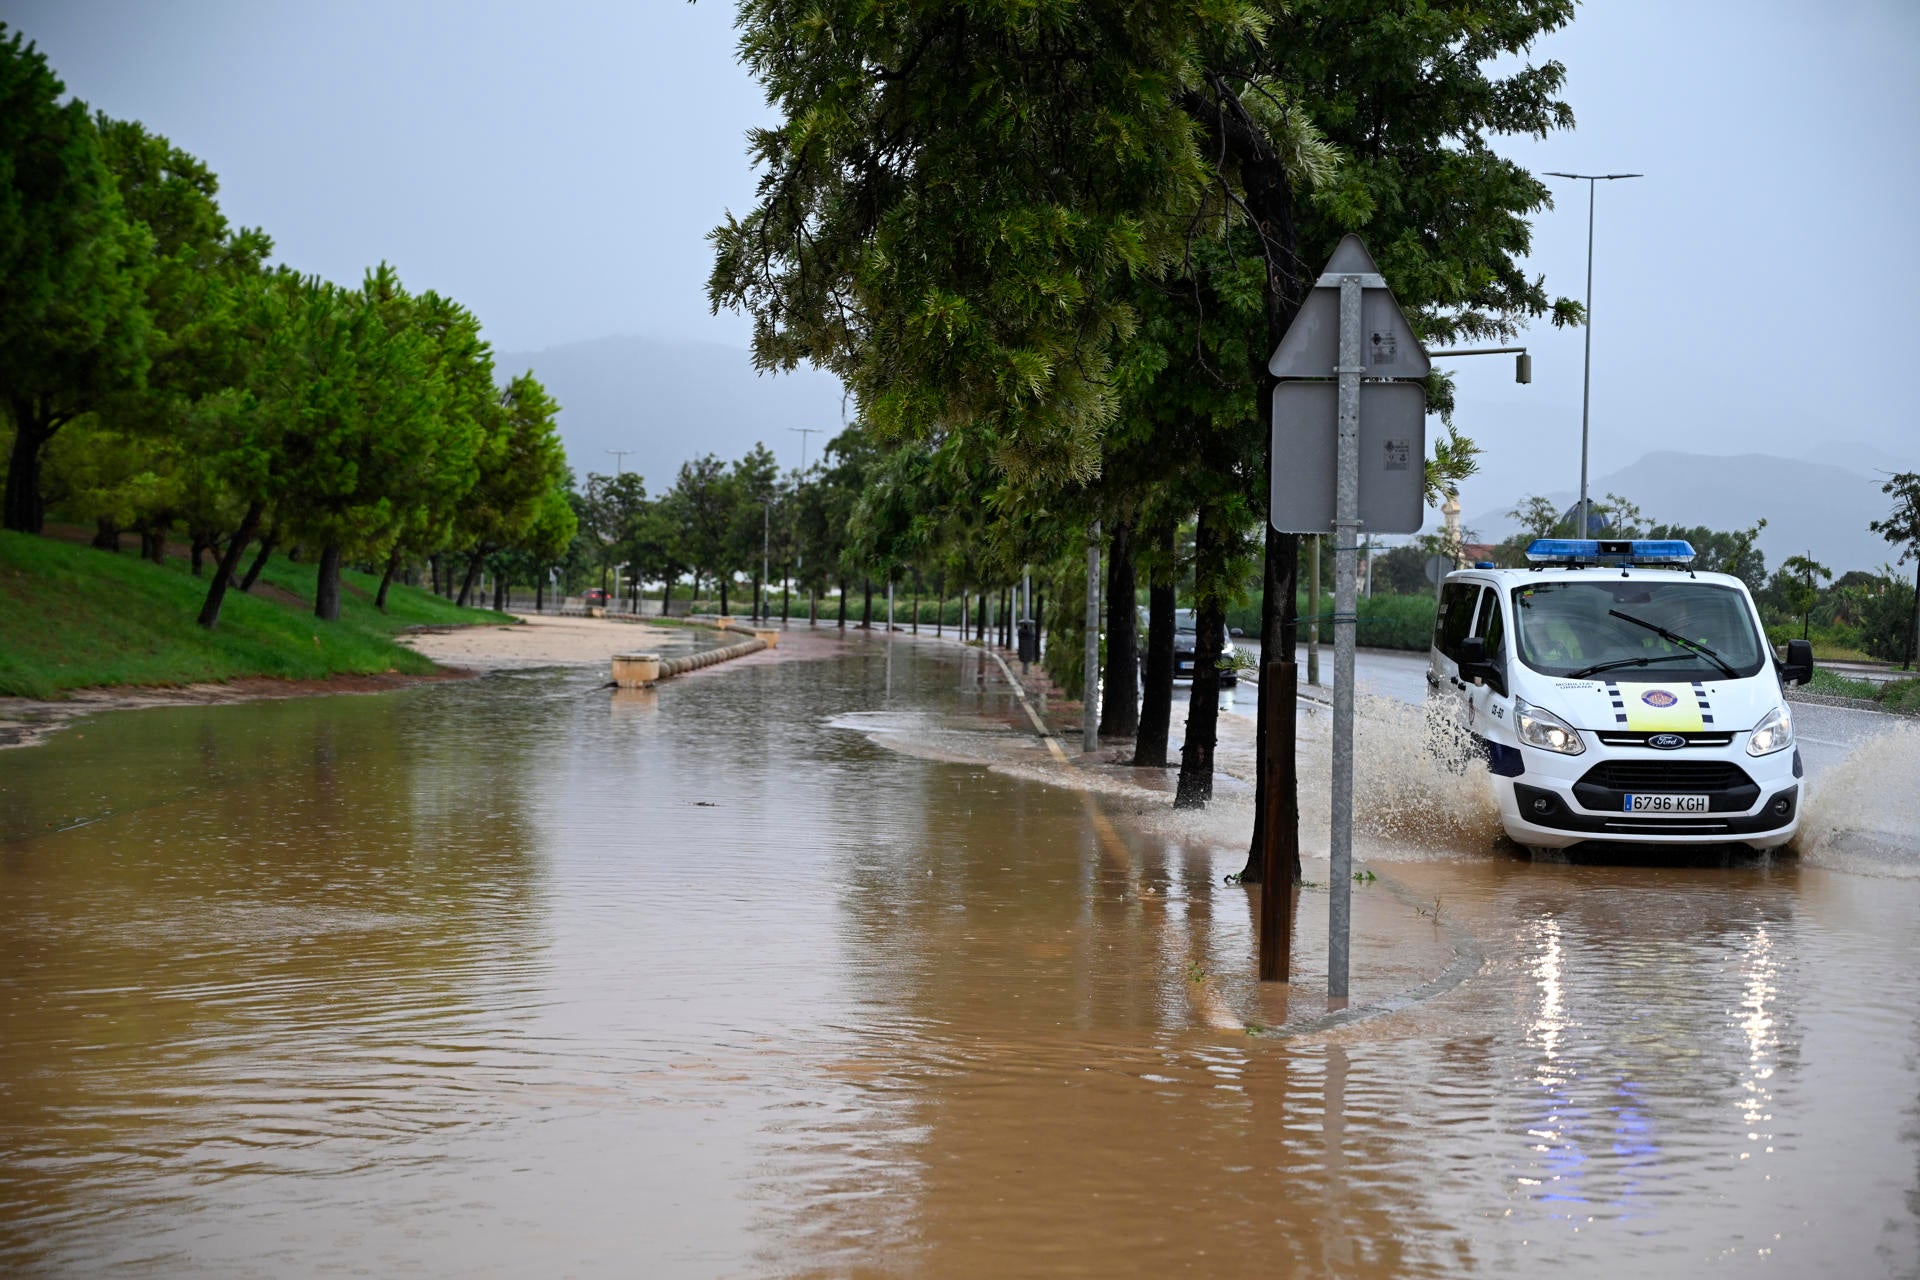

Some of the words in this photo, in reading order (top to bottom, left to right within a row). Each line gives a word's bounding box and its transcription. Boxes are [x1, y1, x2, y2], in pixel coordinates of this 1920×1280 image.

[1656, 735, 1678, 745] Ford
[1634, 796, 1672, 810] 6796
[1676, 797, 1705, 811] KGH
